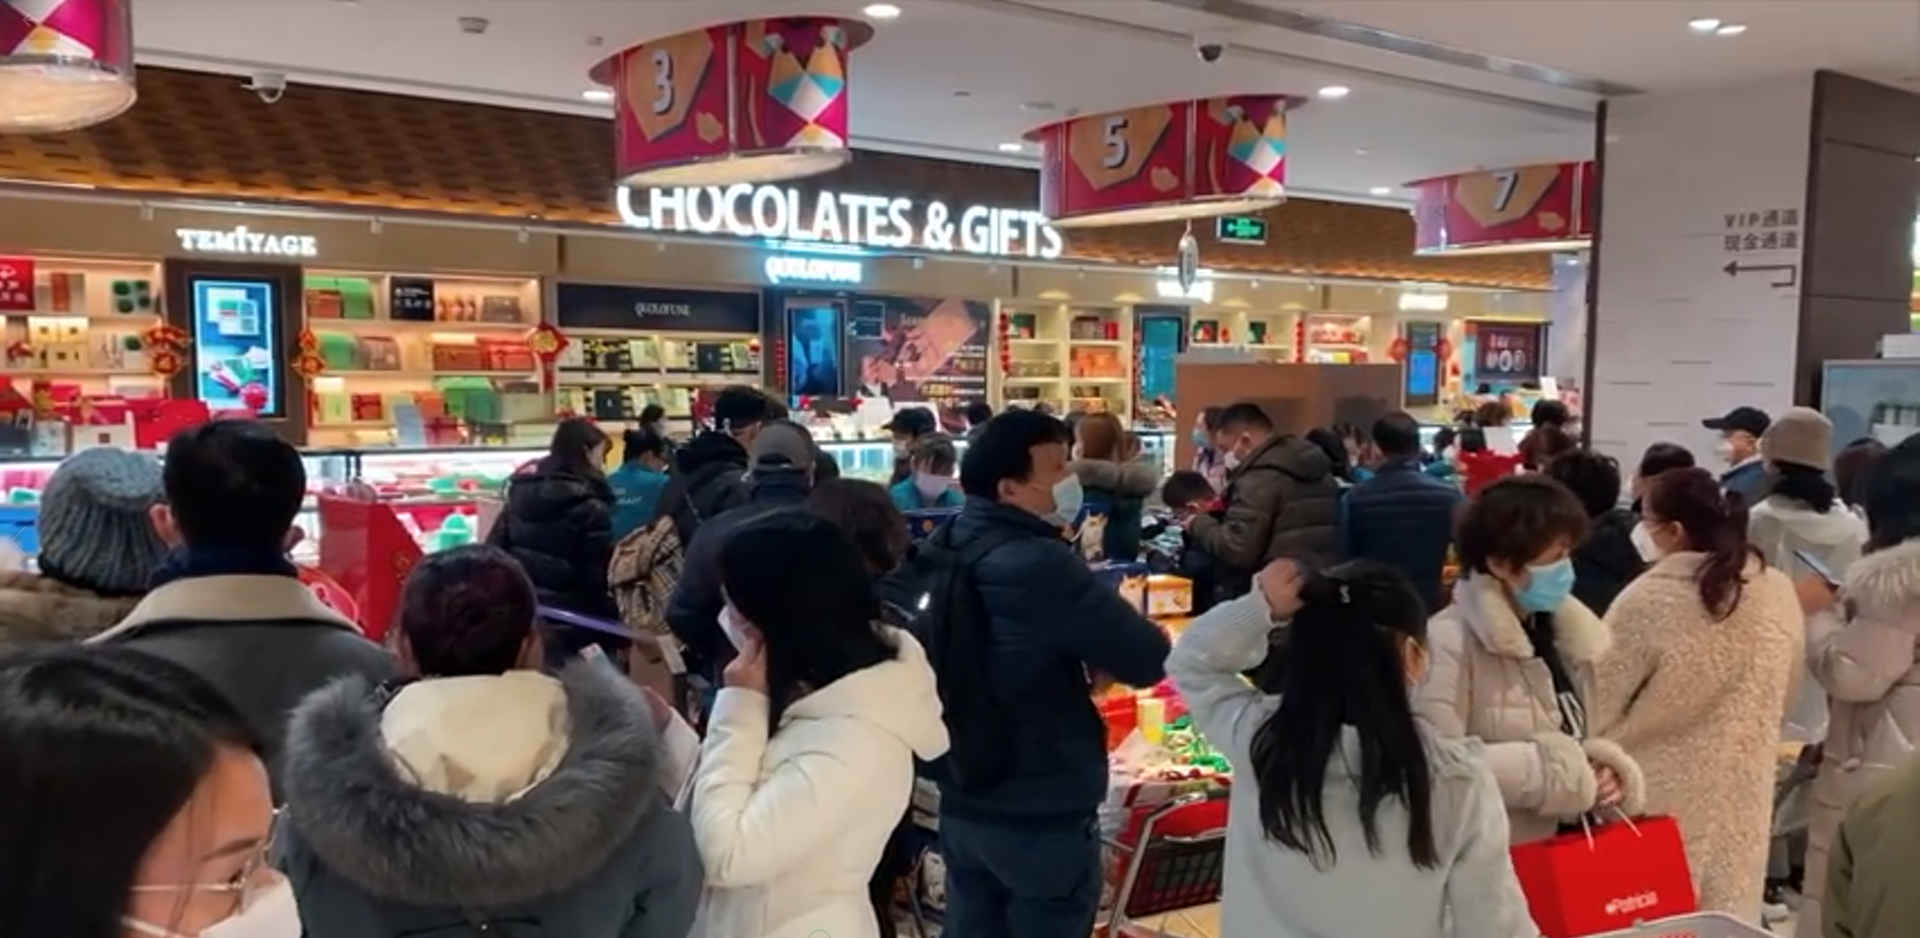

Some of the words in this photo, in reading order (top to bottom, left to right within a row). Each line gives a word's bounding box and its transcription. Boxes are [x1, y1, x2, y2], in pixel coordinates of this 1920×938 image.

[652, 48, 674, 115] 3
[1101, 116, 1129, 170] 5
[1492, 171, 1519, 212] 7
[615, 183, 913, 249] CHOCOLATES
[923, 201, 956, 252] &
[960, 206, 1063, 259] GIFTS
[1724, 231, 1797, 252] 现金通道
